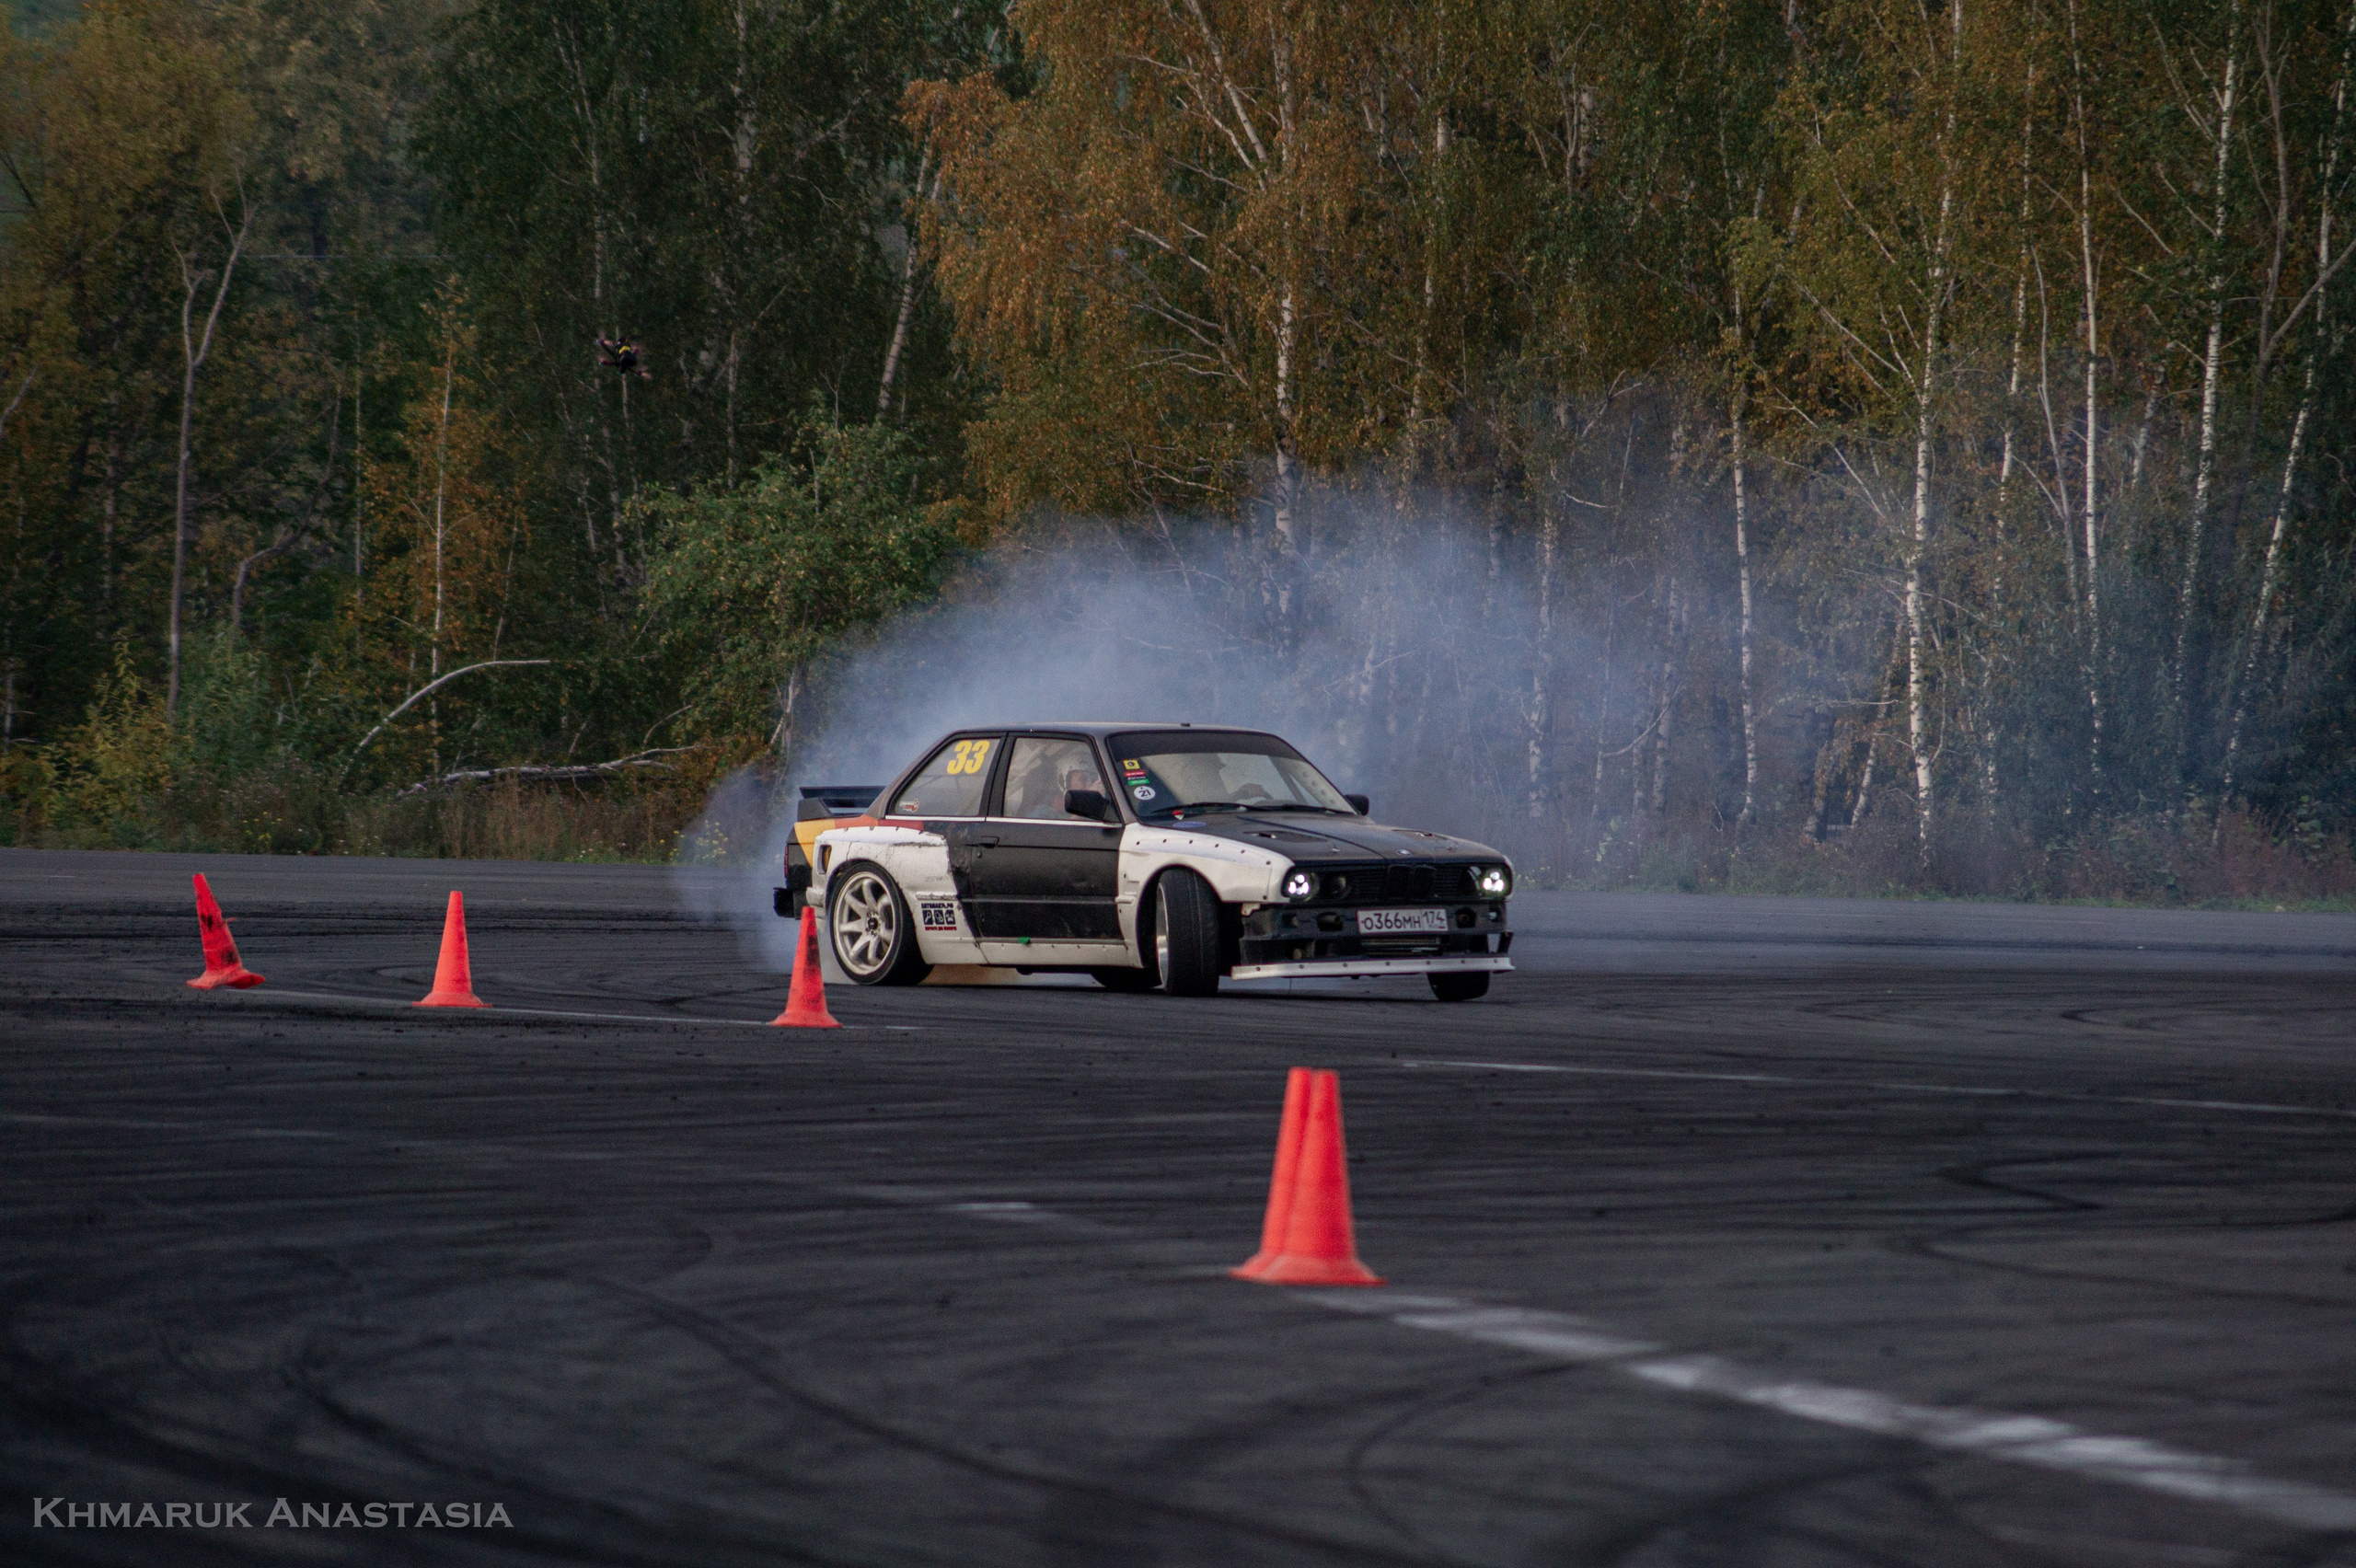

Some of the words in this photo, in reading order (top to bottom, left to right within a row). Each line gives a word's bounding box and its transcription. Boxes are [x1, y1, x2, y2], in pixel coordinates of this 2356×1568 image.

[947, 740, 990, 775] 33
[1138, 789, 1151, 798] 21
[1423, 911, 1445, 924] 174
